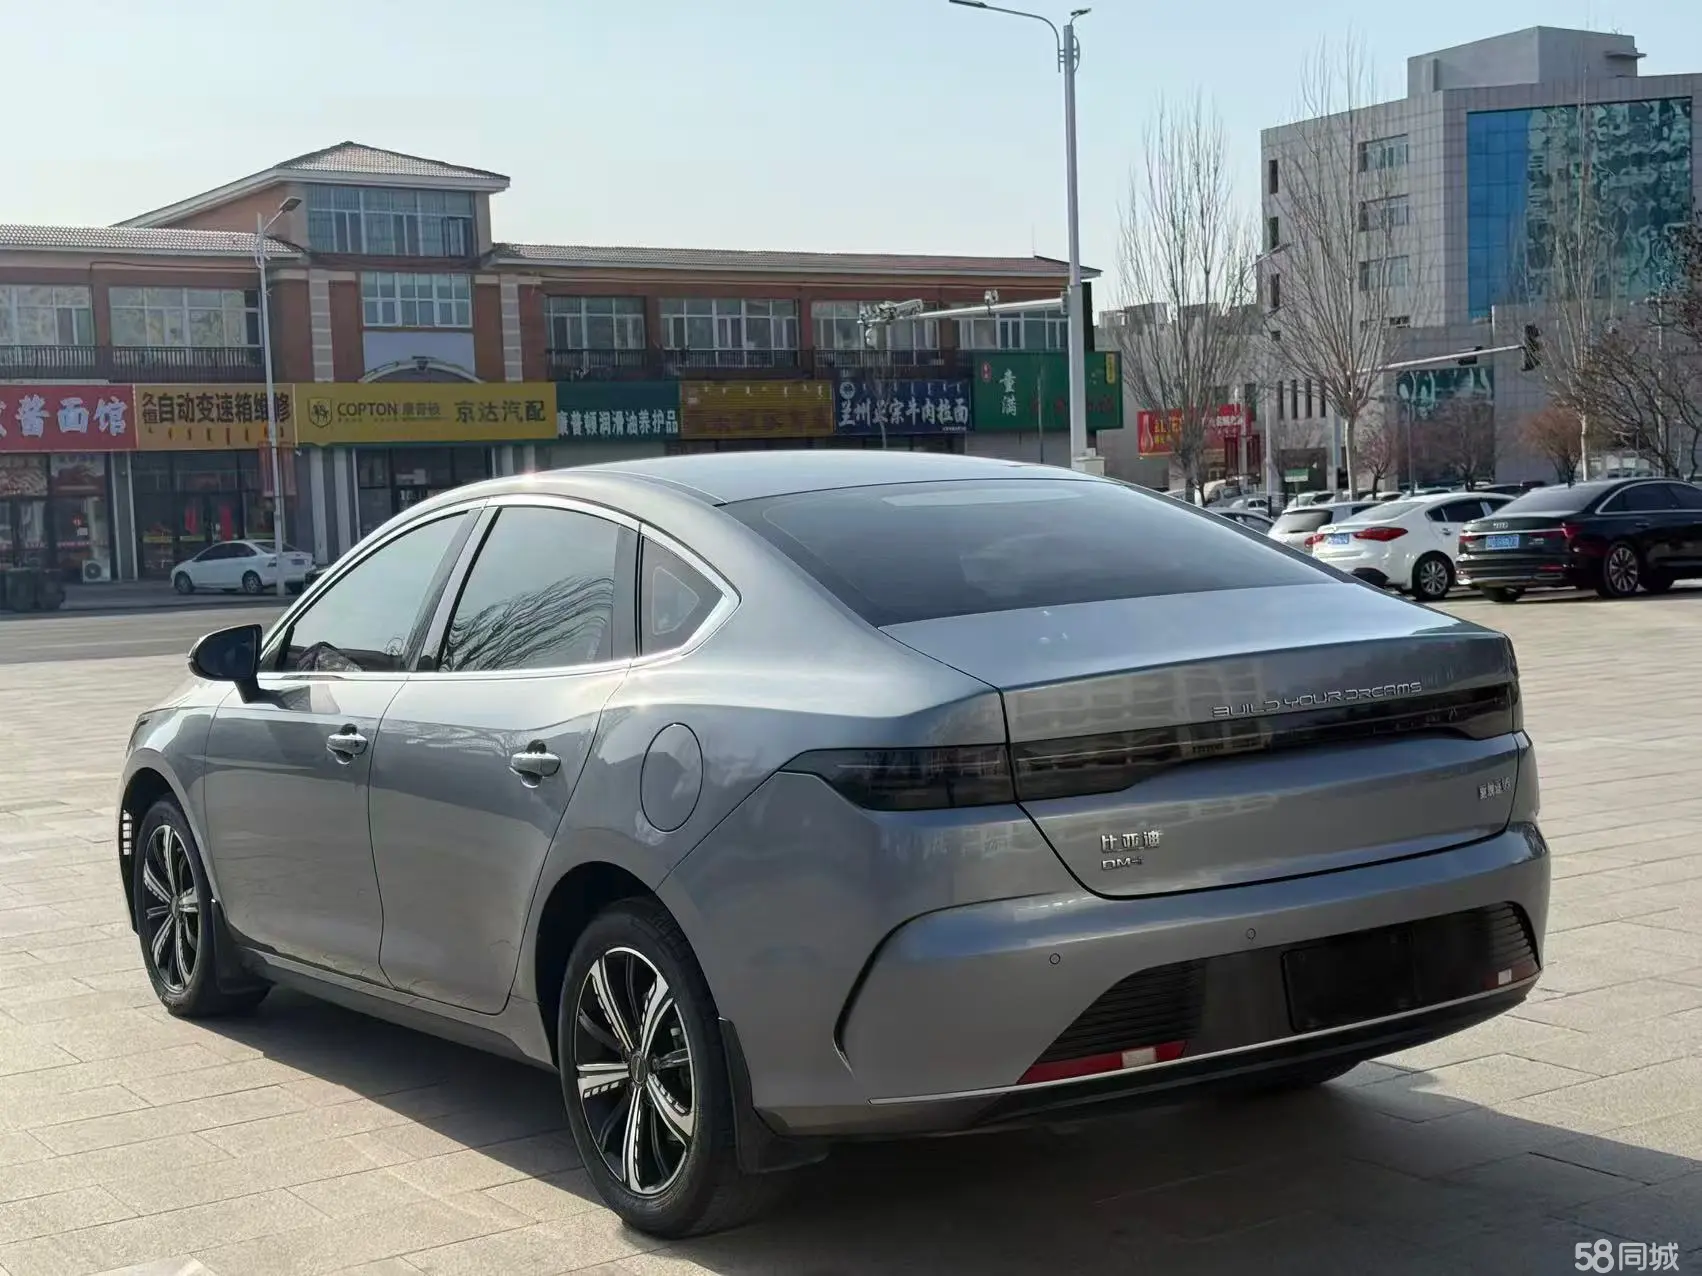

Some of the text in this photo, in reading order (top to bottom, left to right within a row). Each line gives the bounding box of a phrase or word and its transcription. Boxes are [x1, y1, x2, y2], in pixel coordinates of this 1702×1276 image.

[158, 392, 291, 424] 自动变速箱维修
[337, 402, 399, 417] COPTON
[454, 400, 546, 423] 京达汽配
[1212, 682, 1422, 718] BUILD YOUR DREAMS
[1101, 830, 1161, 851] 比亚迪
